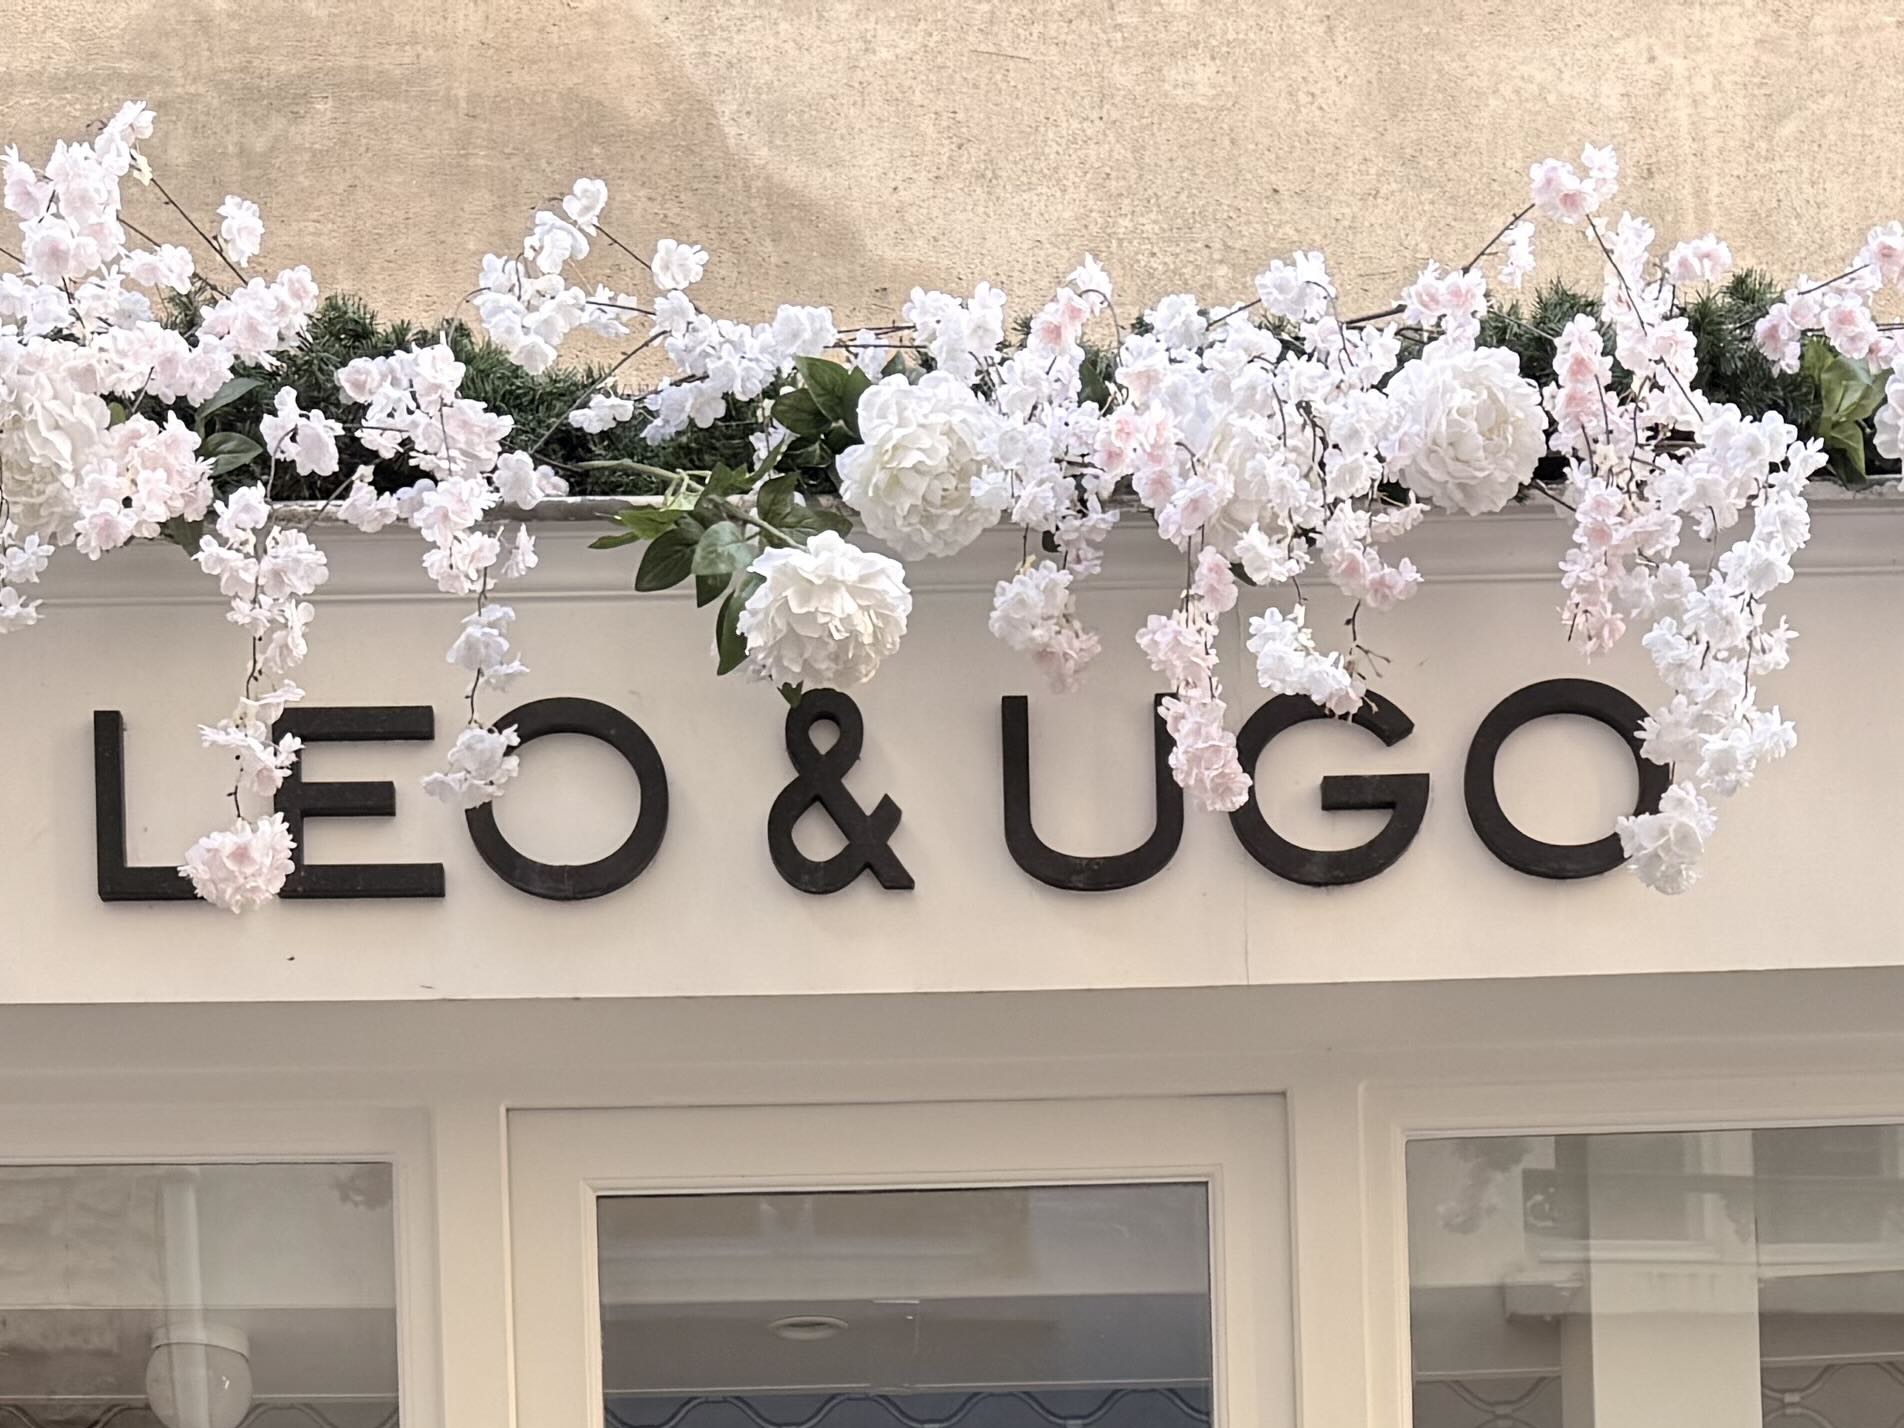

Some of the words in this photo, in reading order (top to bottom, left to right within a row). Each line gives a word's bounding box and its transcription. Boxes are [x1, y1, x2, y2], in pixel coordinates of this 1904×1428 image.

[93, 696, 667, 902] LEO
[767, 688, 915, 895] &
[1000, 677, 1674, 891] UGO
